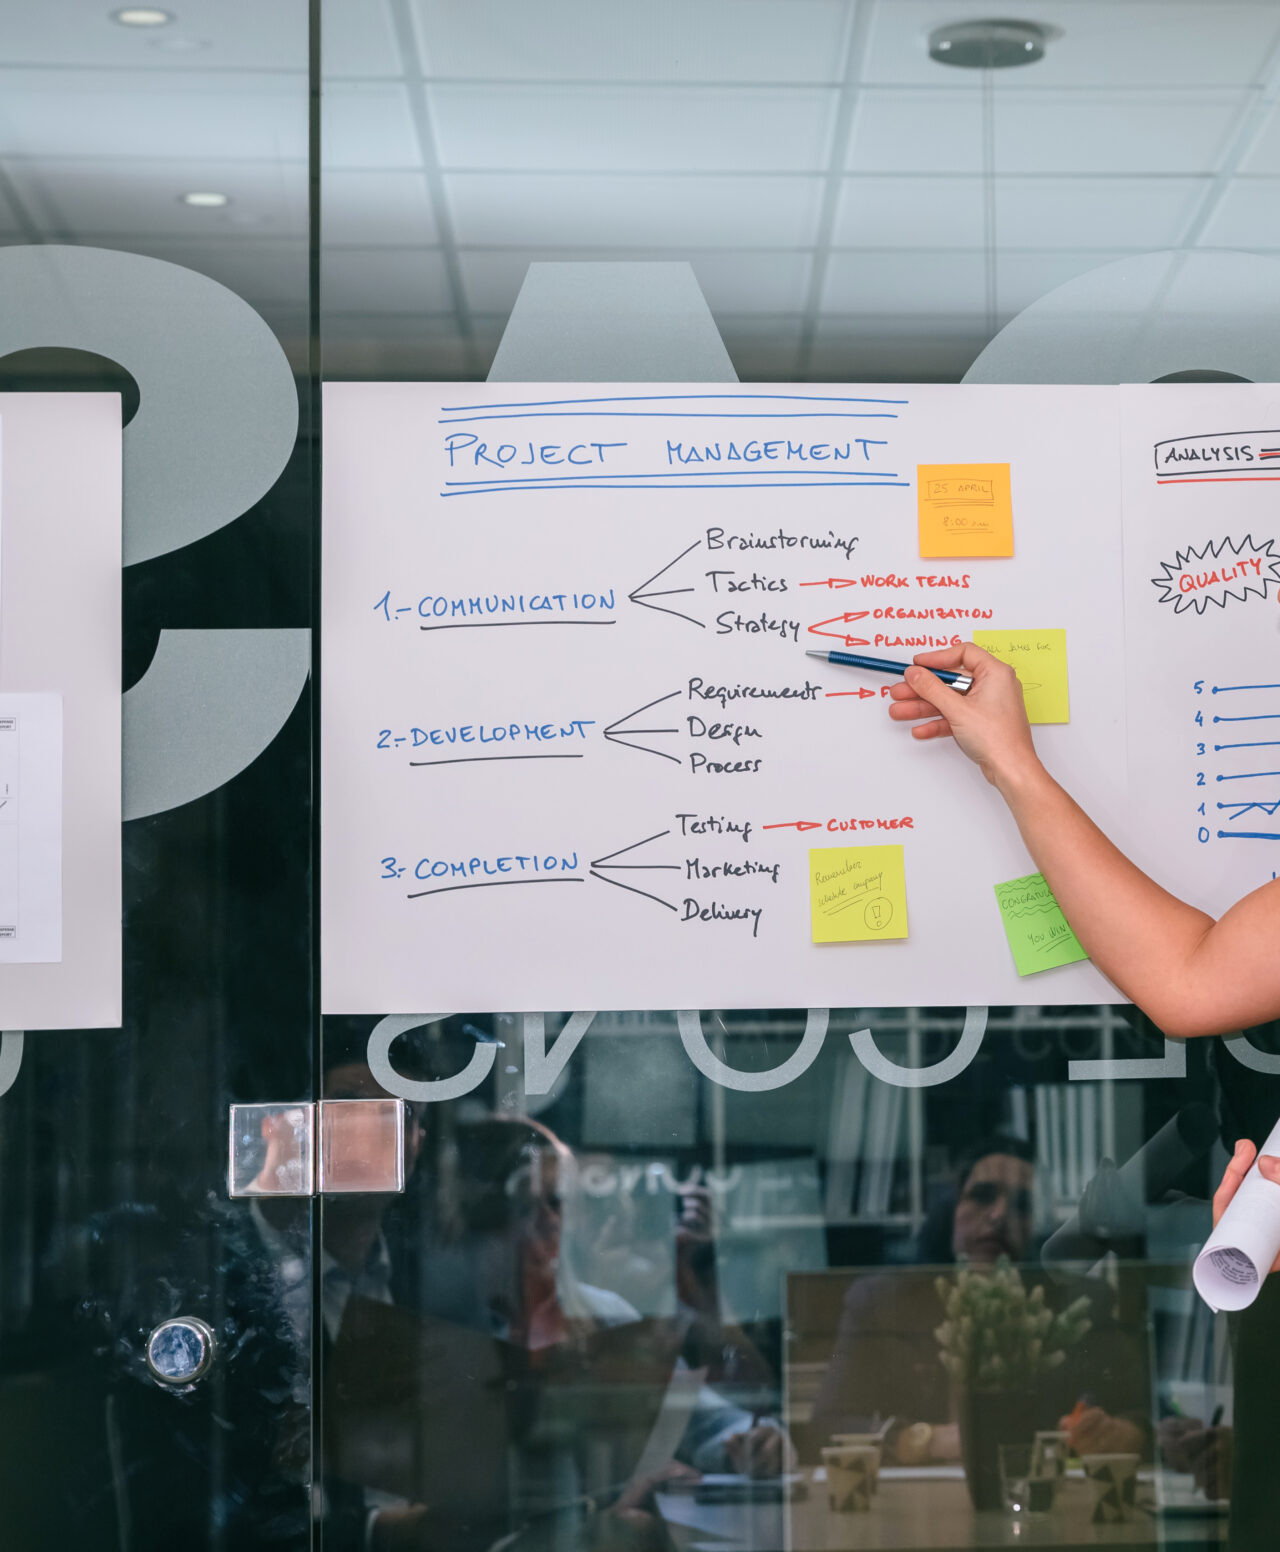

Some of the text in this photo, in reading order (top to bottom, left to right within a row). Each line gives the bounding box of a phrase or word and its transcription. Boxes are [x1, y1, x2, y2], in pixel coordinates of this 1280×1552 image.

[444, 432, 889, 469] PROJECT MANAGEMENT
[1164, 444, 1255, 464] ANALYSIS
[705, 526, 860, 561] Brainstorming
[704, 570, 971, 593] Tactics WORK TEAMS
[1176, 556, 1262, 595] QUALITY
[715, 606, 993, 643] Strategy ORGANIZATION
[872, 632, 964, 648] PLANNING
[688, 676, 823, 710] Requirements
[1193, 679, 1205, 695] 5
[686, 715, 763, 747] Design
[1194, 710, 1204, 727] 4
[1196, 742, 1206, 756] 3
[689, 752, 763, 774] Process
[1196, 771, 1207, 787] 2
[1197, 801, 1206, 817] 1
[674, 813, 915, 843] Testing CUSTOMER
[1197, 826, 1210, 844] 0
[414, 851, 579, 880] COMPLETION
[685, 857, 781, 884] Marketing
[680, 897, 763, 938] Delivery
